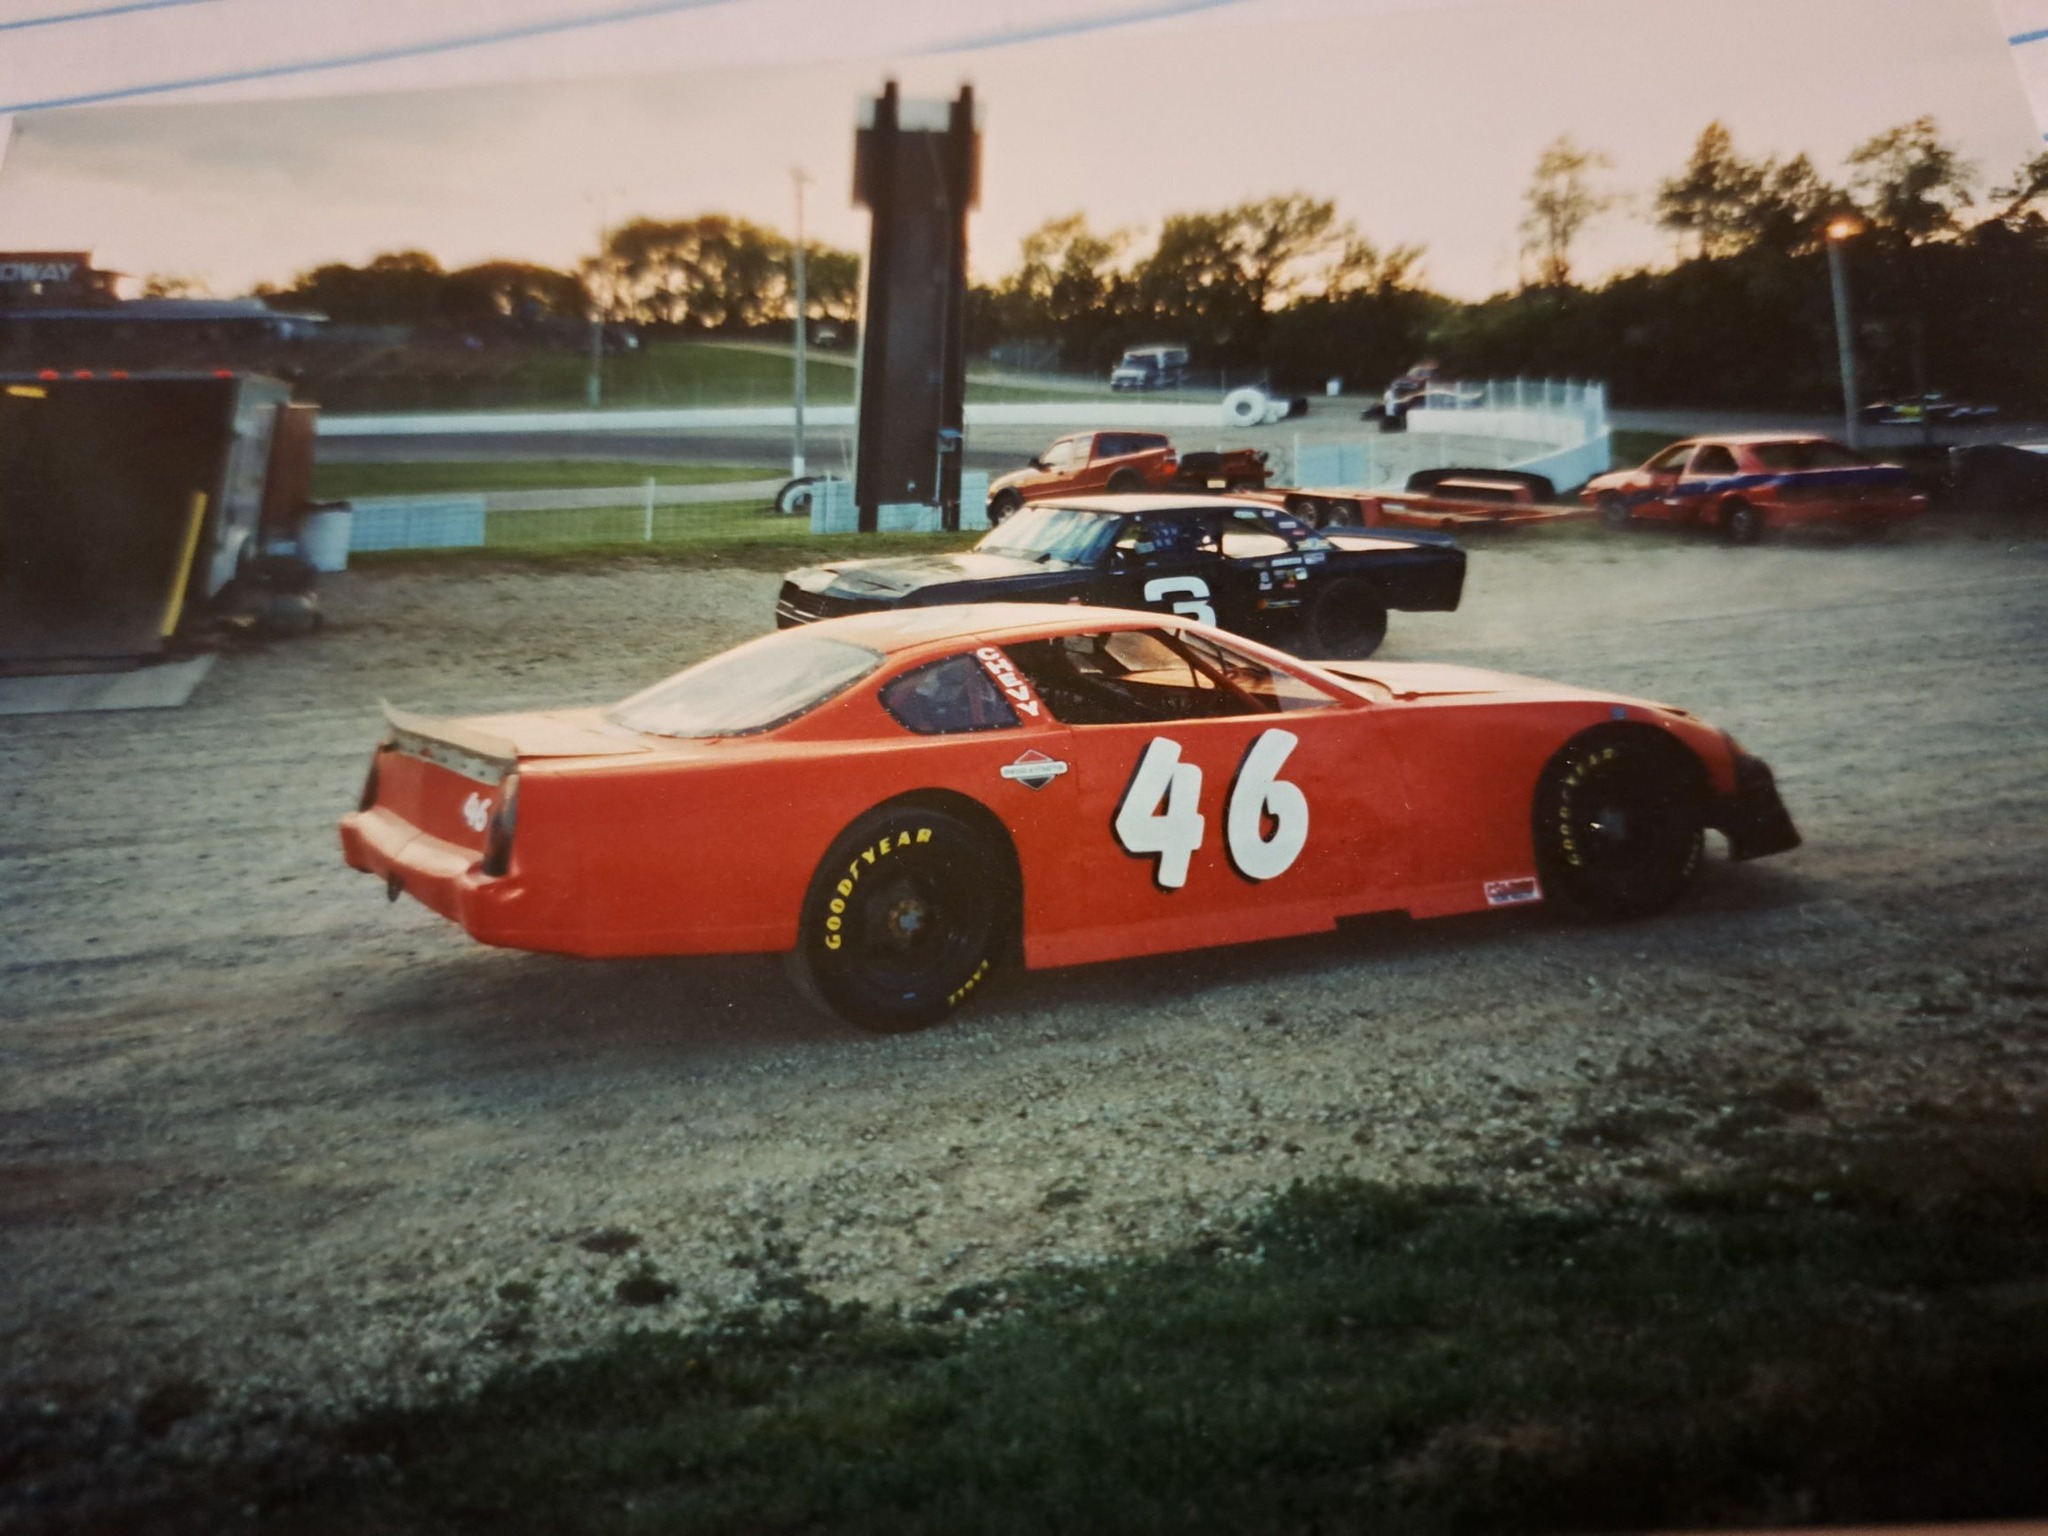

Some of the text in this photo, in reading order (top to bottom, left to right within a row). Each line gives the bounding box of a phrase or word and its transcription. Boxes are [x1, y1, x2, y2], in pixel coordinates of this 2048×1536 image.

[976, 647, 1039, 716] CHEVY
[1111, 728, 1309, 891] 46
[825, 828, 932, 949] GOODYEAR
